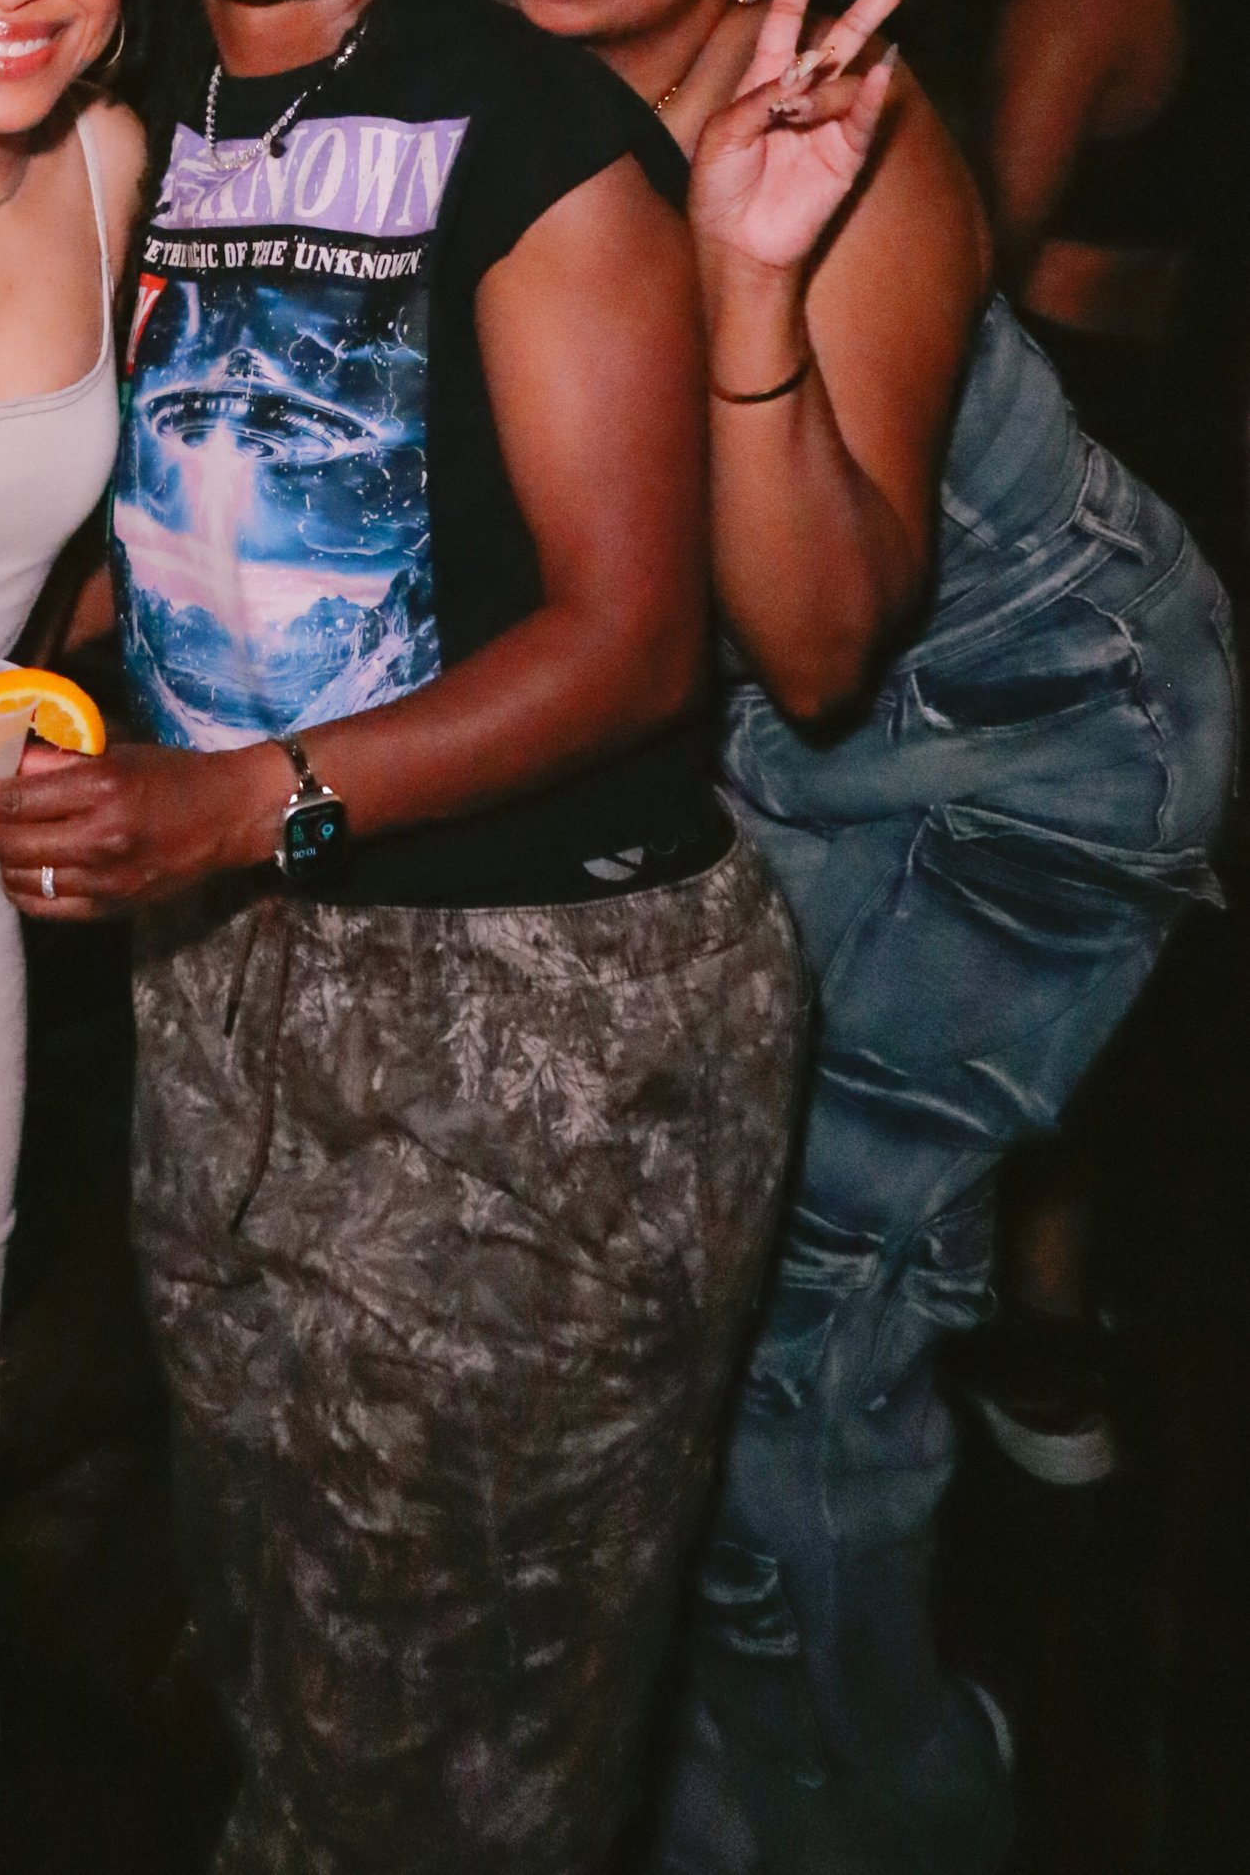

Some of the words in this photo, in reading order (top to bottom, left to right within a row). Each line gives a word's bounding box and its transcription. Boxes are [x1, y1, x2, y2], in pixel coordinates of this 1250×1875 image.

[223, 241, 249, 268] OF
[251, 239, 289, 267] THE
[293, 236, 423, 280] UNKNOWN
